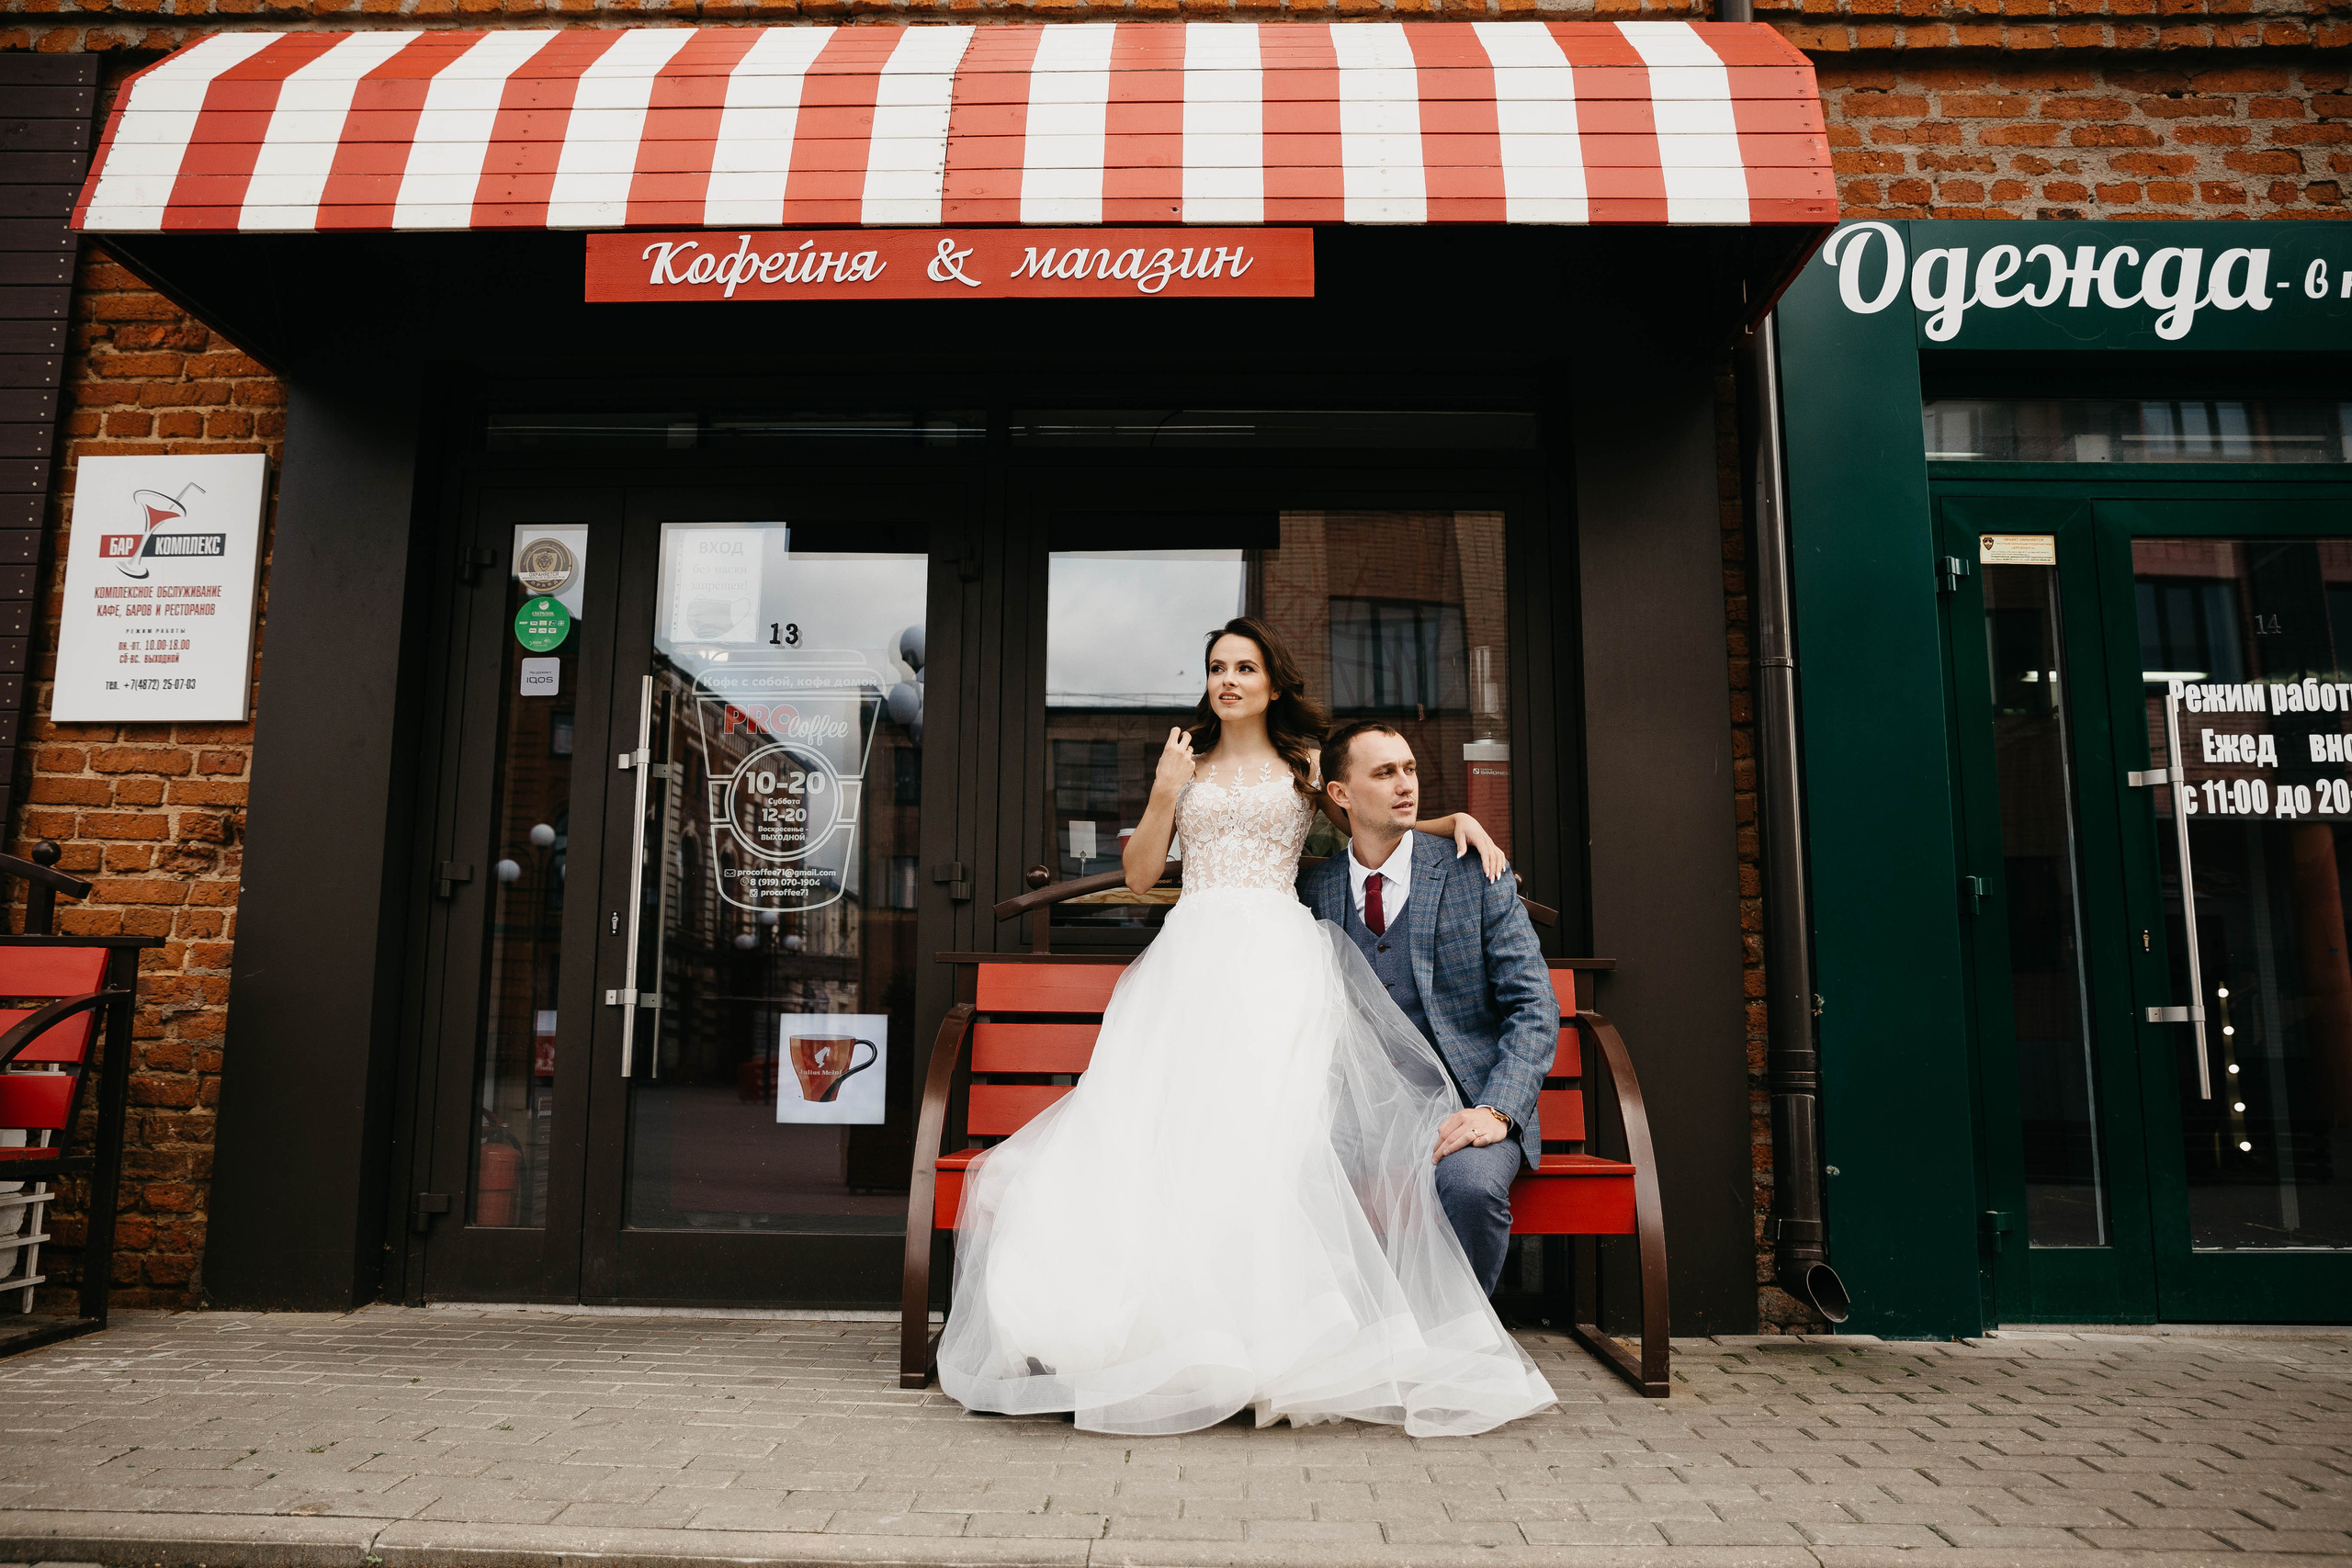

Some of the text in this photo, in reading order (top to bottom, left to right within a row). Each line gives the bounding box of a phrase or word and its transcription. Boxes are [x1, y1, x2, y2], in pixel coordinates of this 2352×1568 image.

[641, 234, 1255, 299] Кофейня & магазин
[109, 536, 221, 556] БАР КОМПЛЕКС
[698, 541, 744, 557] ВХОД
[692, 563, 748, 574] без маски
[94, 585, 222, 599] КОМПЛЕКСНОЕ ОБСЛУЖИВАНИЕ
[690, 580, 749, 592] запрещен!
[96, 604, 216, 618] КАФЕ, БАРОВ И РЕСТОРАНОВ
[2255, 614, 2282, 635] 14
[769, 623, 799, 645] 13
[145, 638, 190, 650] 10.00-18.00
[163, 678, 197, 690] 25-07-03
[526, 676, 554, 684] IQOS
[703, 675, 877, 689] Кофе с собой, кофе домой
[2168, 677, 2352, 716] Режим работ
[724, 704, 849, 746] PRO Coffee
[2201, 728, 2278, 768] Ежед
[746, 771, 826, 795] 10-20
[767, 797, 801, 807] Суббота
[2183, 784, 2199, 815] с
[2201, 779, 2269, 815] 11:00
[2276, 784, 2312, 819] до
[762, 807, 808, 822] 12-20
[761, 832, 806, 841] ВЫХОДНОЙ
[737, 868, 837, 878] procoffee71@gmail.com
[750, 878, 820, 886] 8 (919) 070-1904
[761, 888, 809, 897] procoffee71
